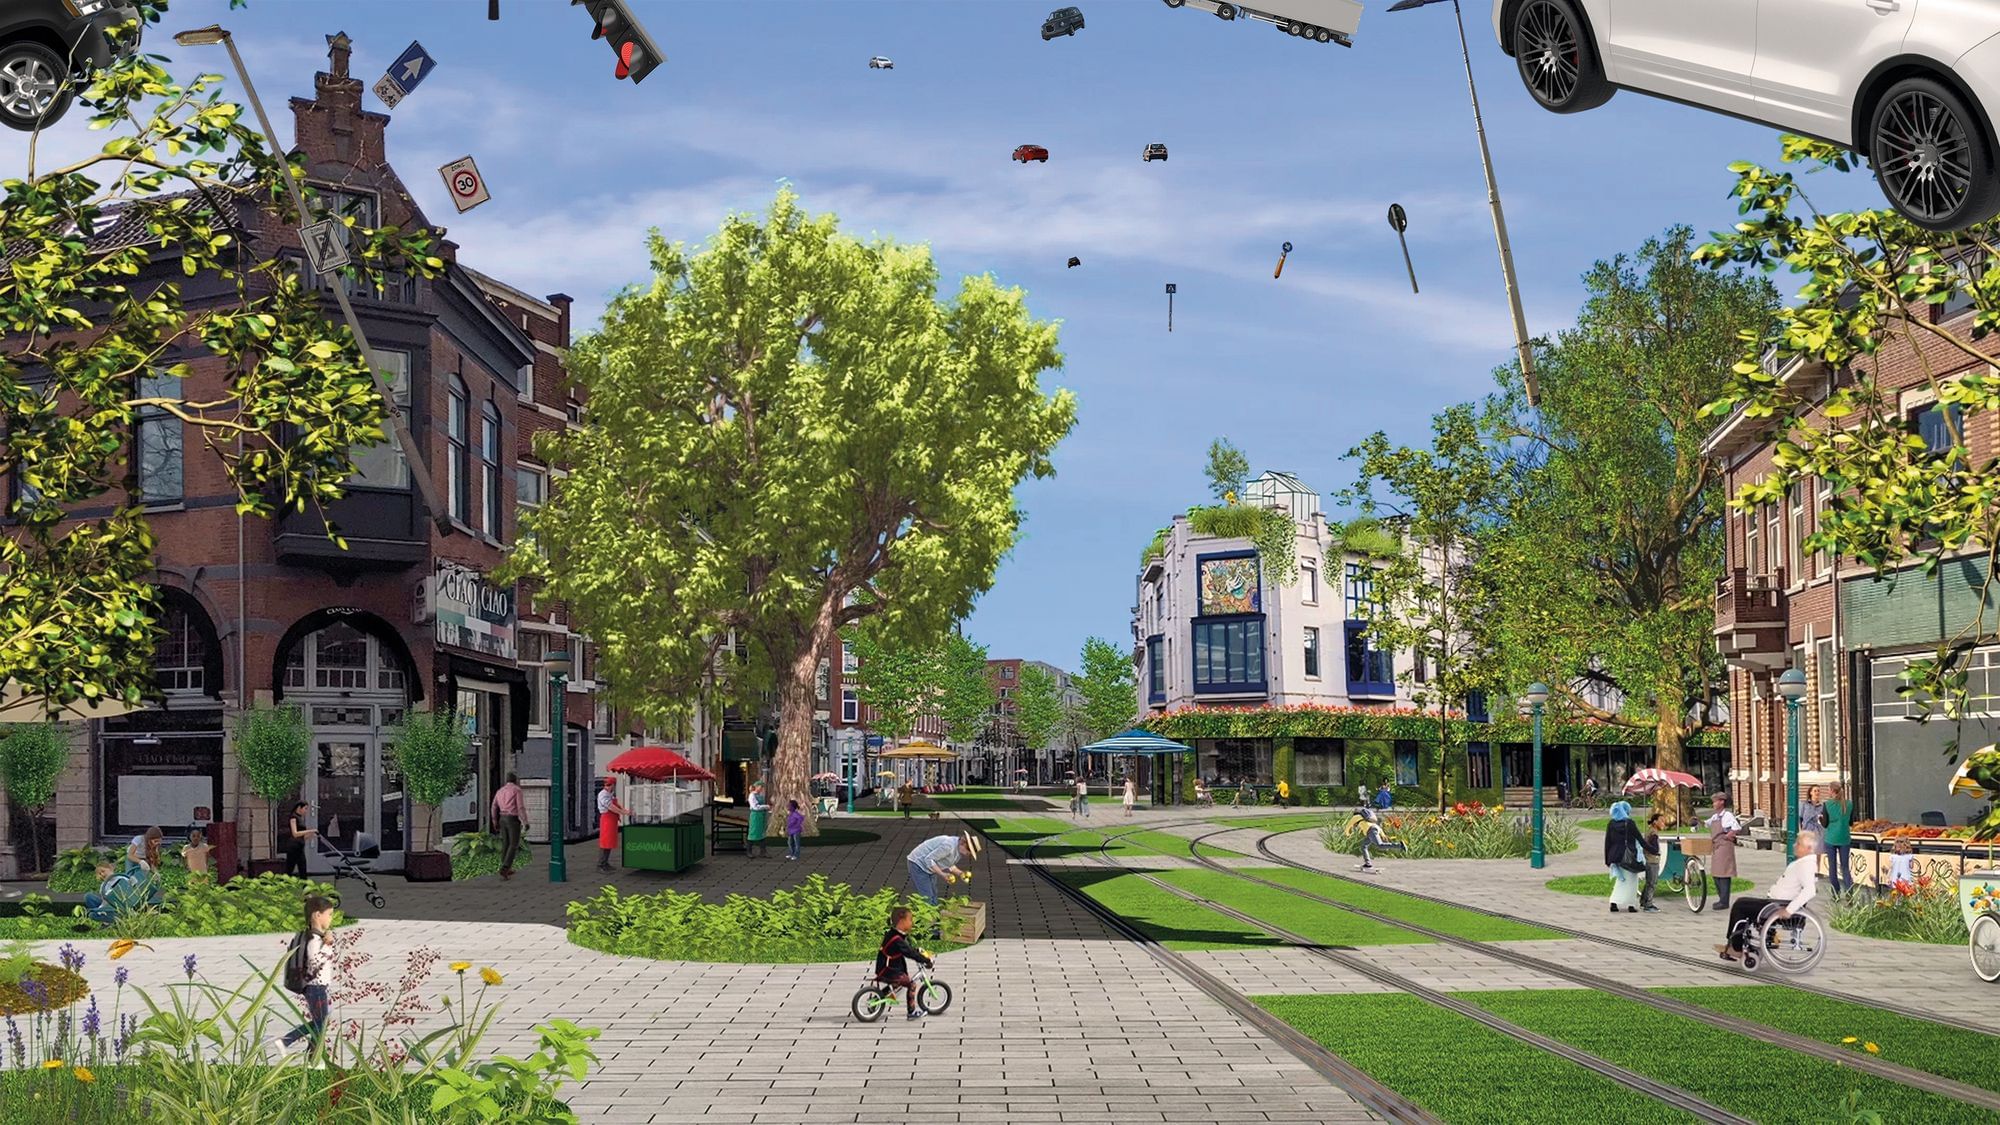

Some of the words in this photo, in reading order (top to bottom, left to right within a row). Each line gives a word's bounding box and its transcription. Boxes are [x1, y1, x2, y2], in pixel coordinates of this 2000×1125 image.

[457, 176, 474, 191] 30
[446, 573, 477, 606] CIAO
[481, 586, 508, 617] CIAO
[625, 841, 672, 852] REGIONAAL
